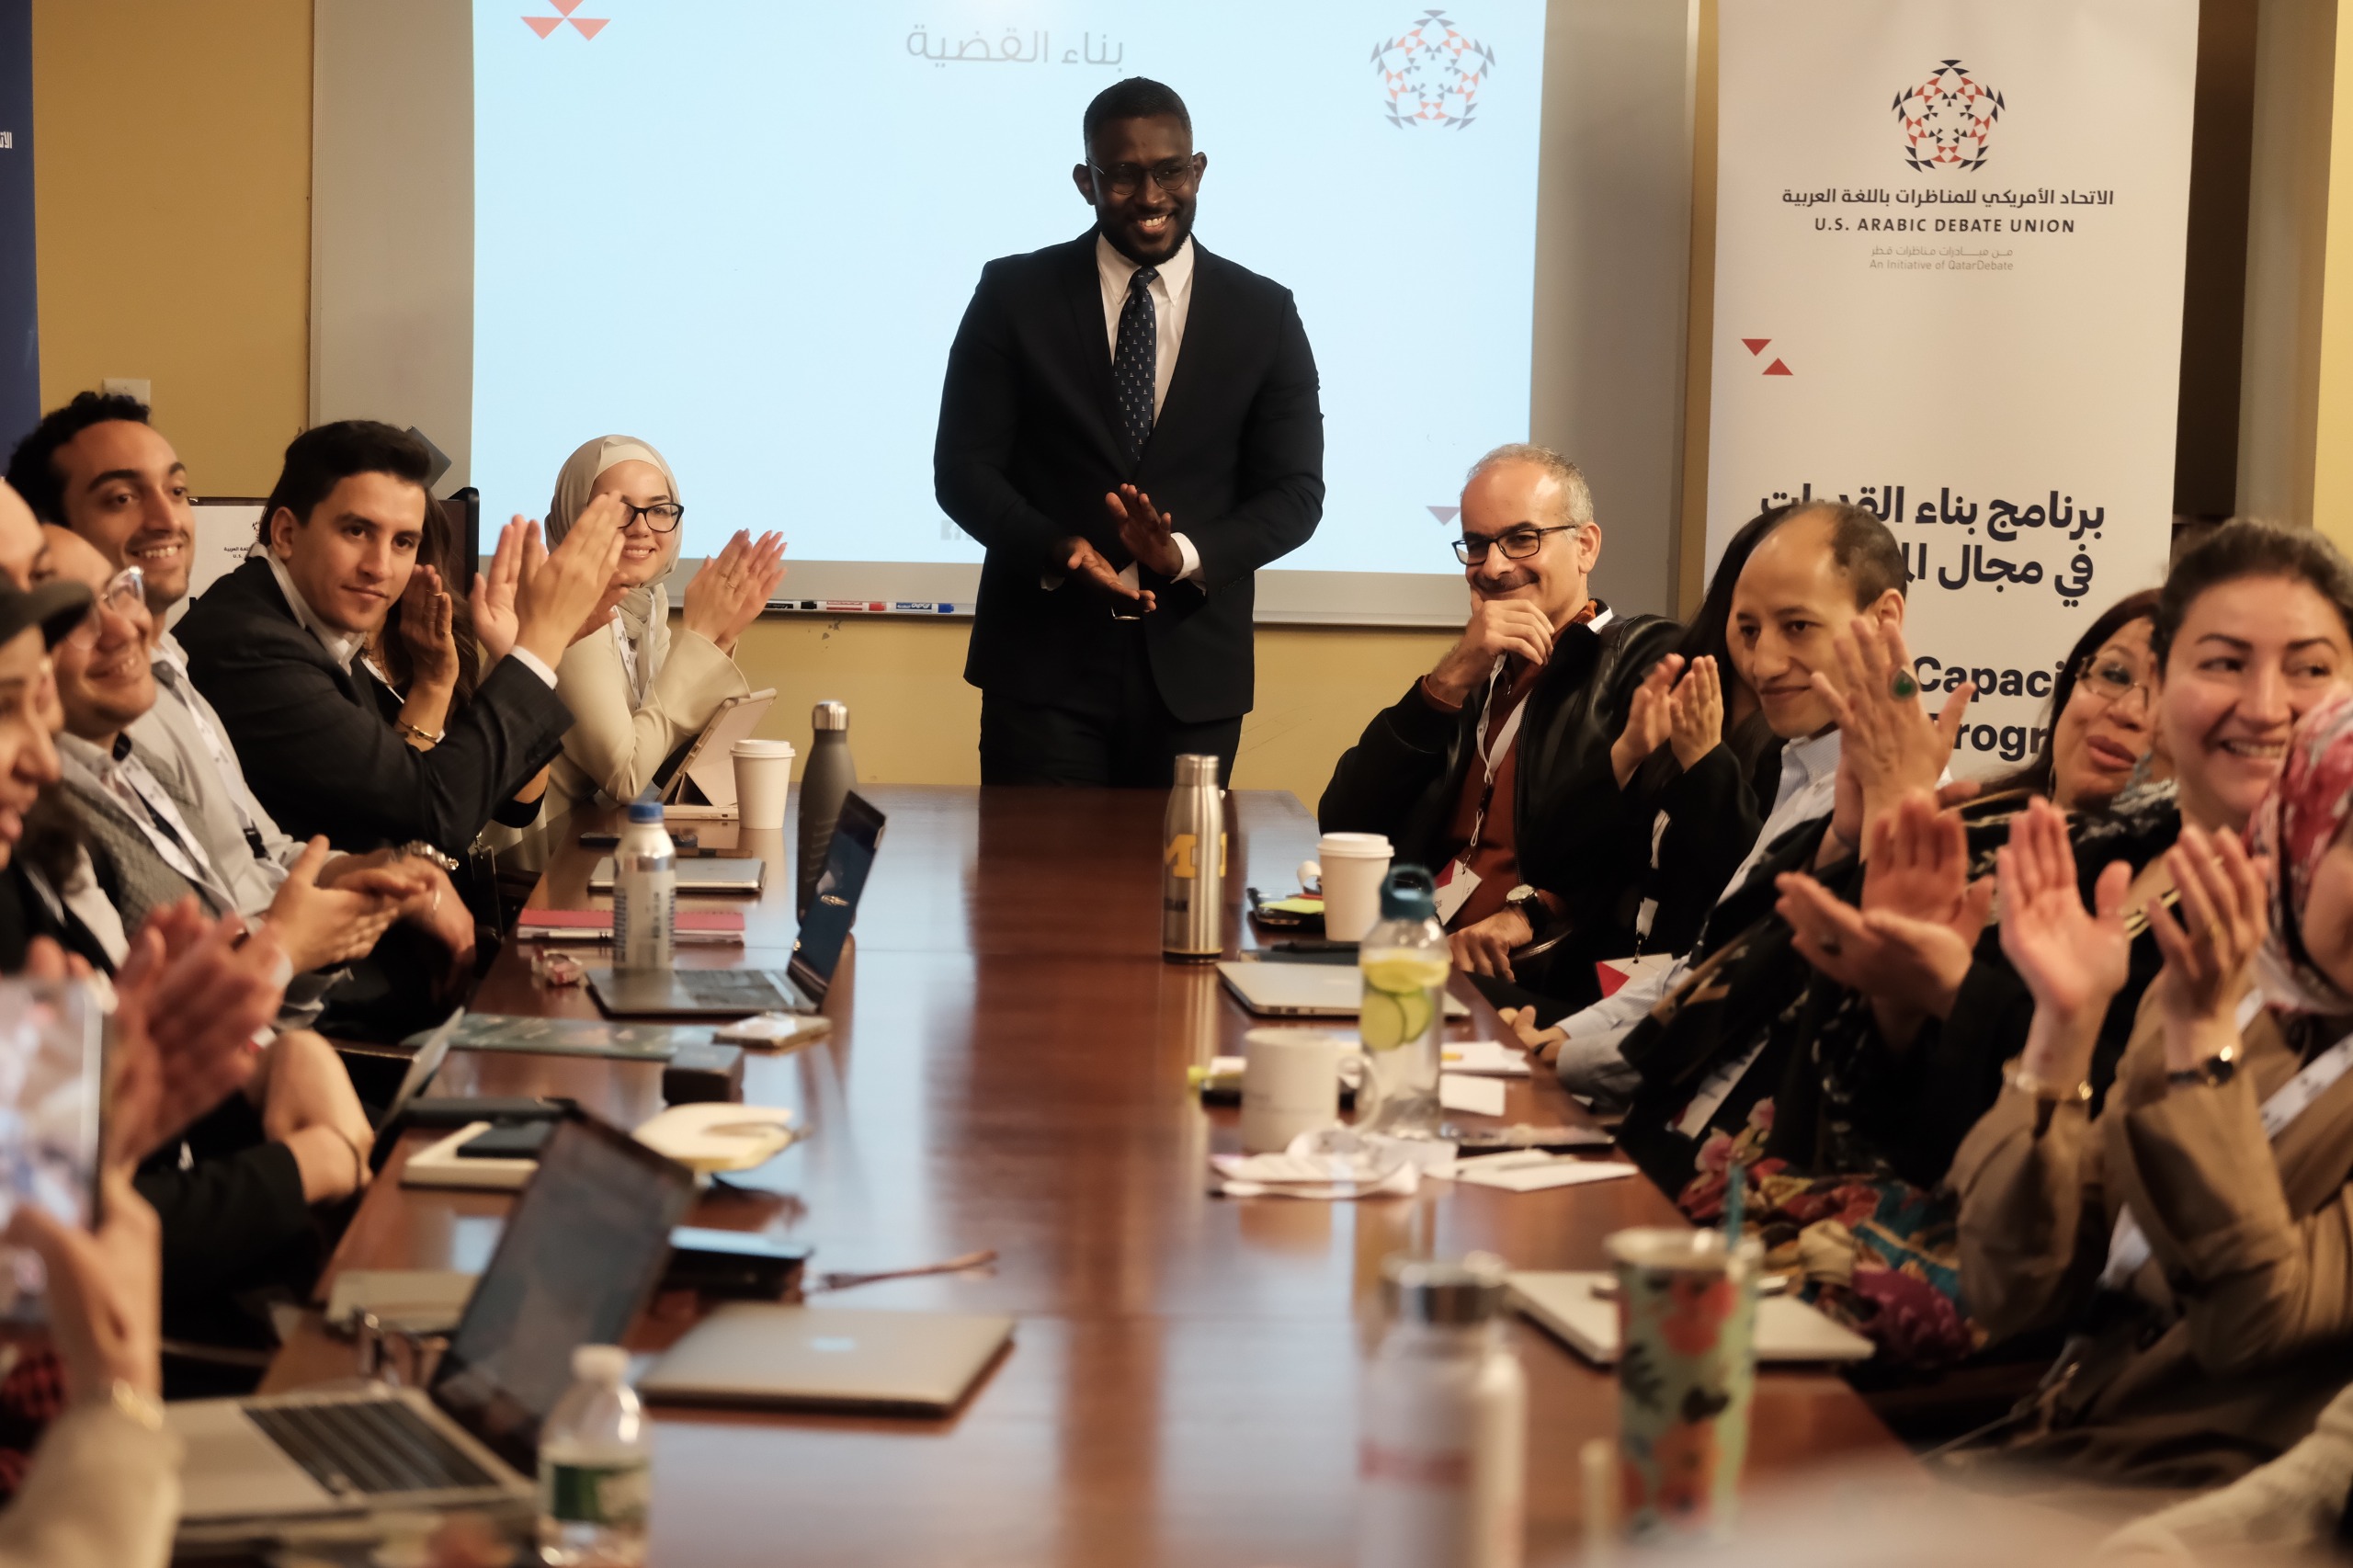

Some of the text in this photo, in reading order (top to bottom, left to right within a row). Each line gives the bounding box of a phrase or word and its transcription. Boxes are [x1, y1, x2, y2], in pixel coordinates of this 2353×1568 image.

[906, 24, 1122, 73] بناء القضية
[1782, 188, 2114, 209] الاتحاد الأمريكي للمناظرات باللغة العربية
[1814, 218, 2075, 233] U.S. ARABIC DEBATE UNION
[1870, 260, 2014, 271] An Initiative of QatarDebate
[1871, 245, 1893, 258] قطر
[1915, 487, 1978, 535] بناء
[1986, 491, 2105, 541] برنامج
[1938, 544, 2043, 593] مجال
[2054, 543, 2094, 608] في
[1914, 656, 2065, 702] Capaci
